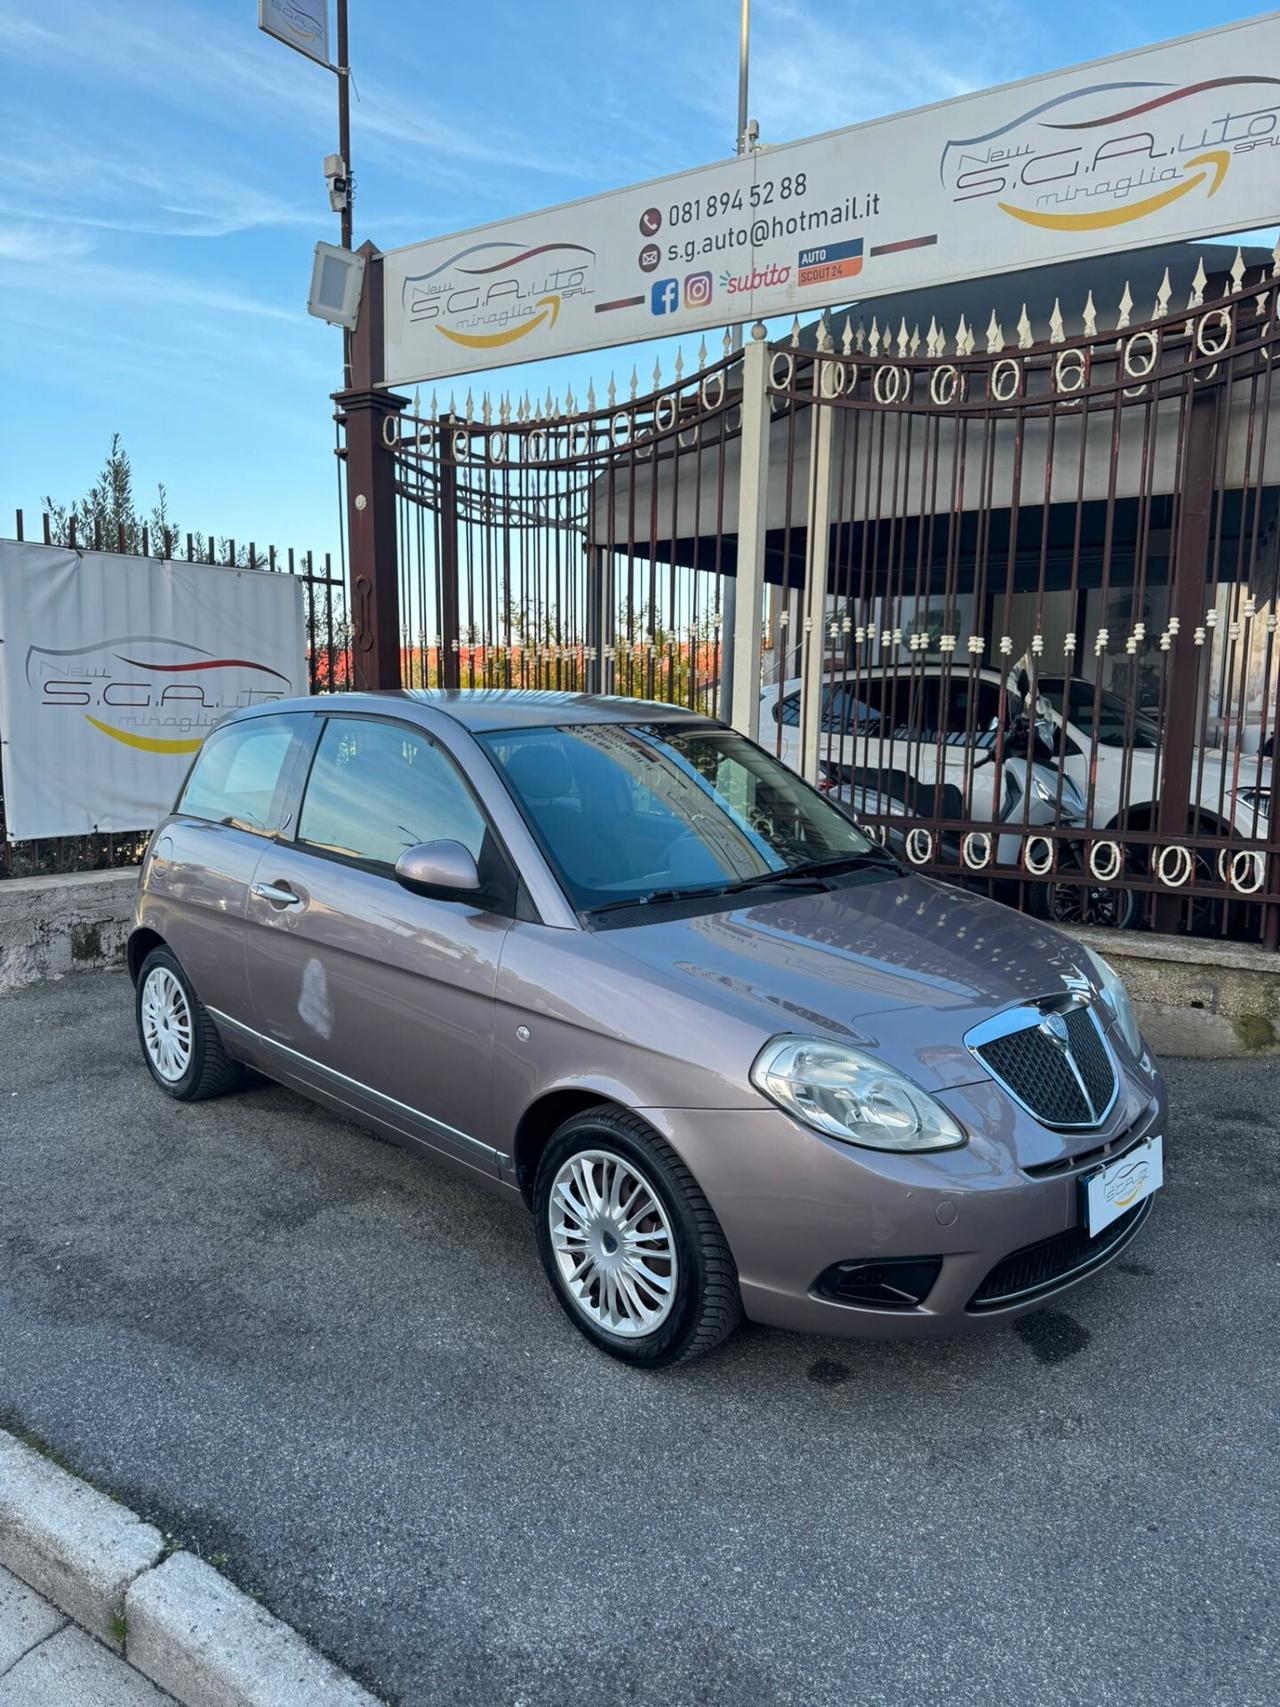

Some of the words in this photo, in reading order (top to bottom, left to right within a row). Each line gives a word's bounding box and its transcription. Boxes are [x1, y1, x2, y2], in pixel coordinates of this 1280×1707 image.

[958, 144, 1035, 170] New
[669, 200, 700, 227] 081
[706, 189, 743, 218] 894
[750, 181, 774, 208] 52
[780, 172, 807, 200] 88
[1035, 166, 1184, 207] miraglia
[667, 193, 880, 263] s.g.auto@hotmail.it
[801, 249, 827, 265] AUTO
[412, 282, 455, 299] New
[726, 262, 792, 294] subito
[456, 303, 537, 327] miraglia
[40, 660, 112, 678] New
